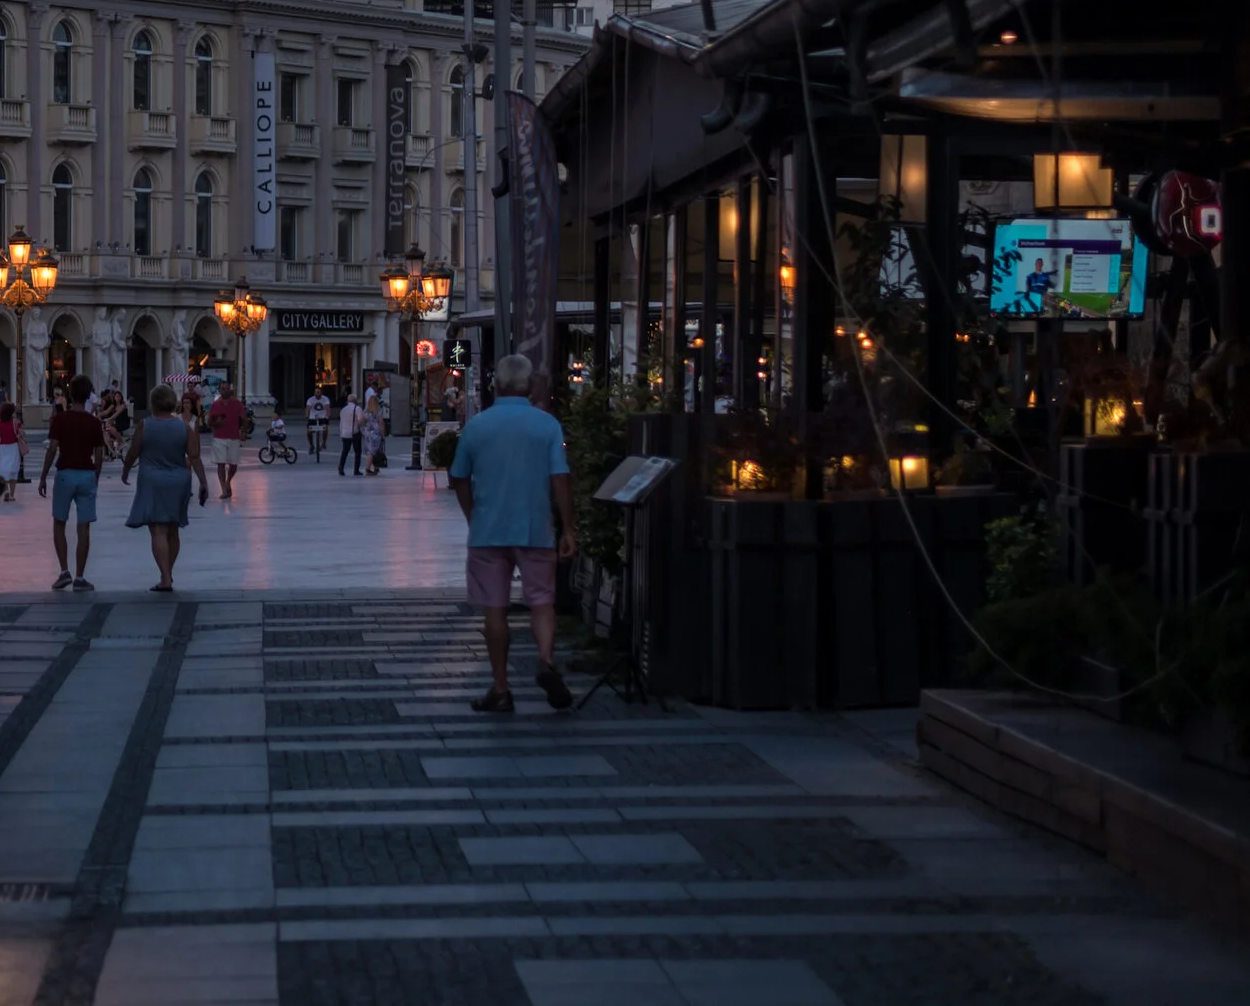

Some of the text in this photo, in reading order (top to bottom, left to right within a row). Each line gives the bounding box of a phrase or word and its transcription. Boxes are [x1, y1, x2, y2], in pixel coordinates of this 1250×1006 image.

[257, 80, 272, 214] CALLIOPE
[282, 313, 362, 329] CITY GALLERY
